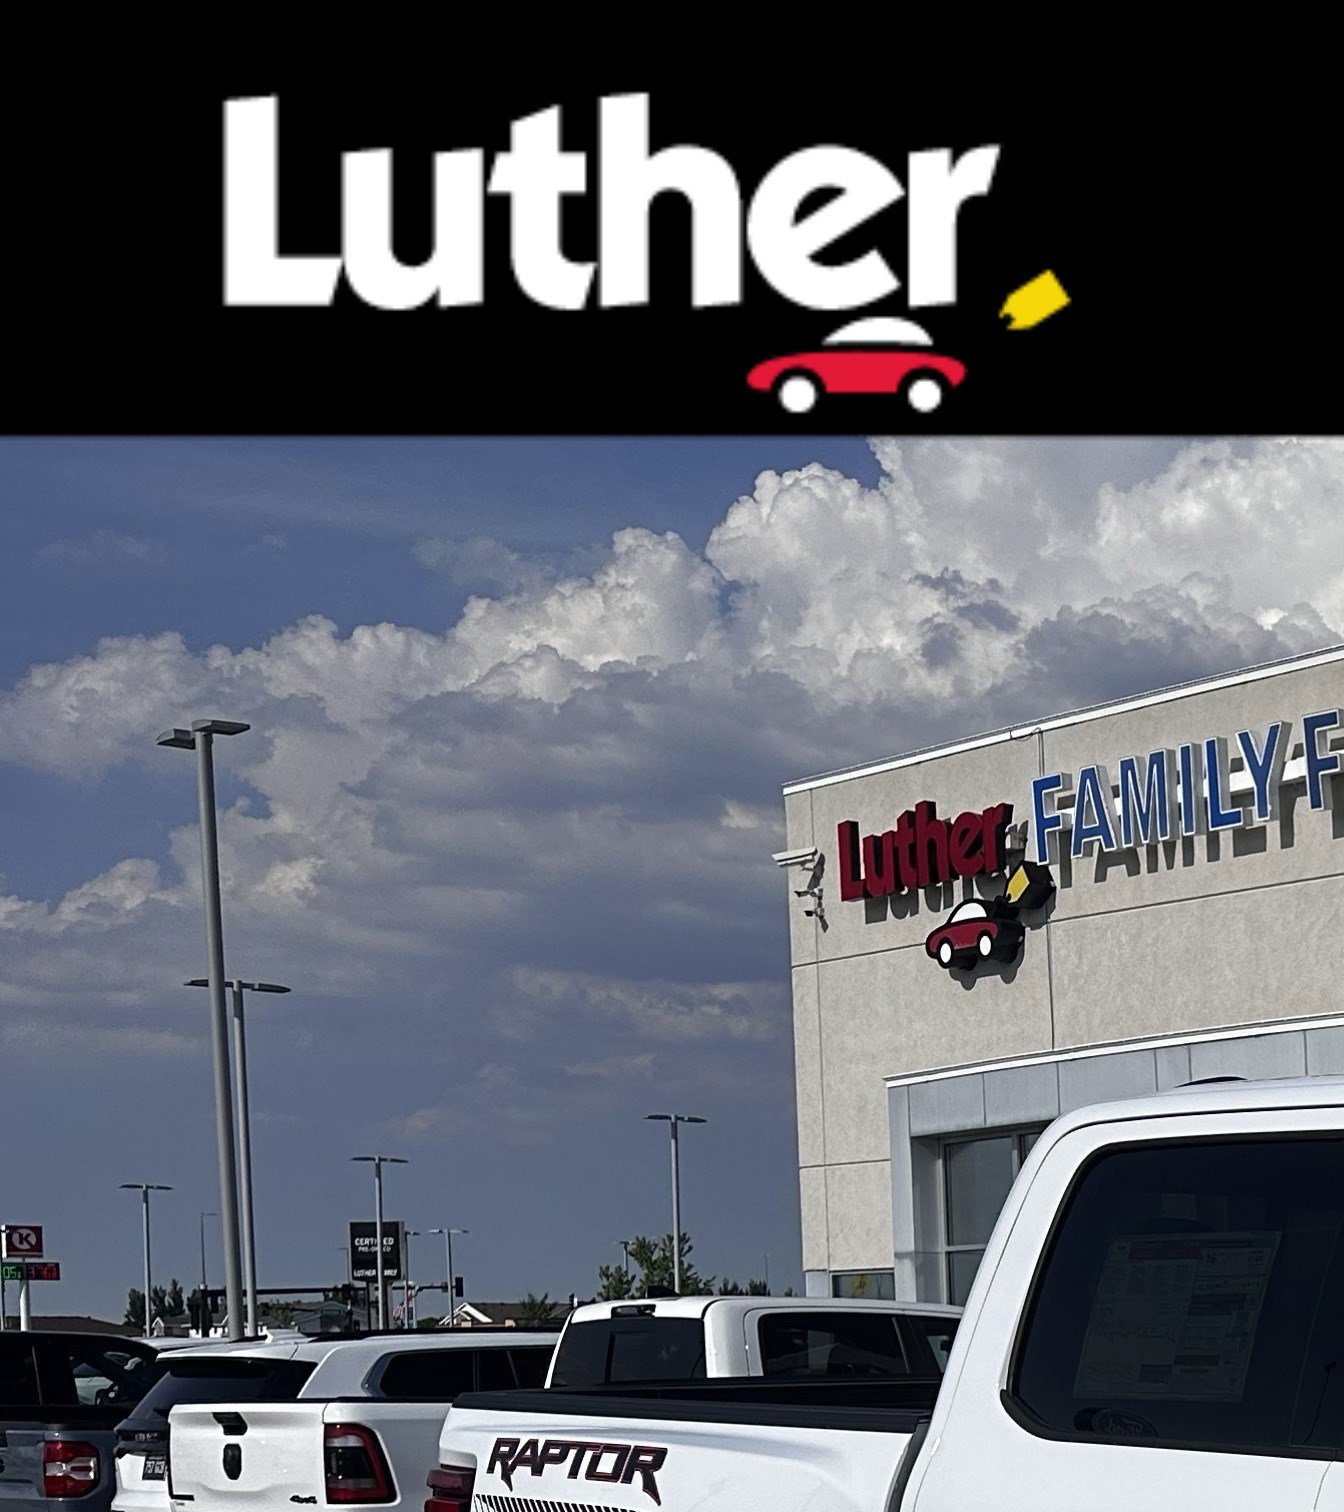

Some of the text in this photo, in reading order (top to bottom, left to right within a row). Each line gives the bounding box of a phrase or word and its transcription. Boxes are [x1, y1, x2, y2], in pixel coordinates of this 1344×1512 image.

[1032, 720, 1290, 864] FAMILY
[838, 800, 1014, 902] Luther
[486, 1437, 668, 1506] RAPTOR
